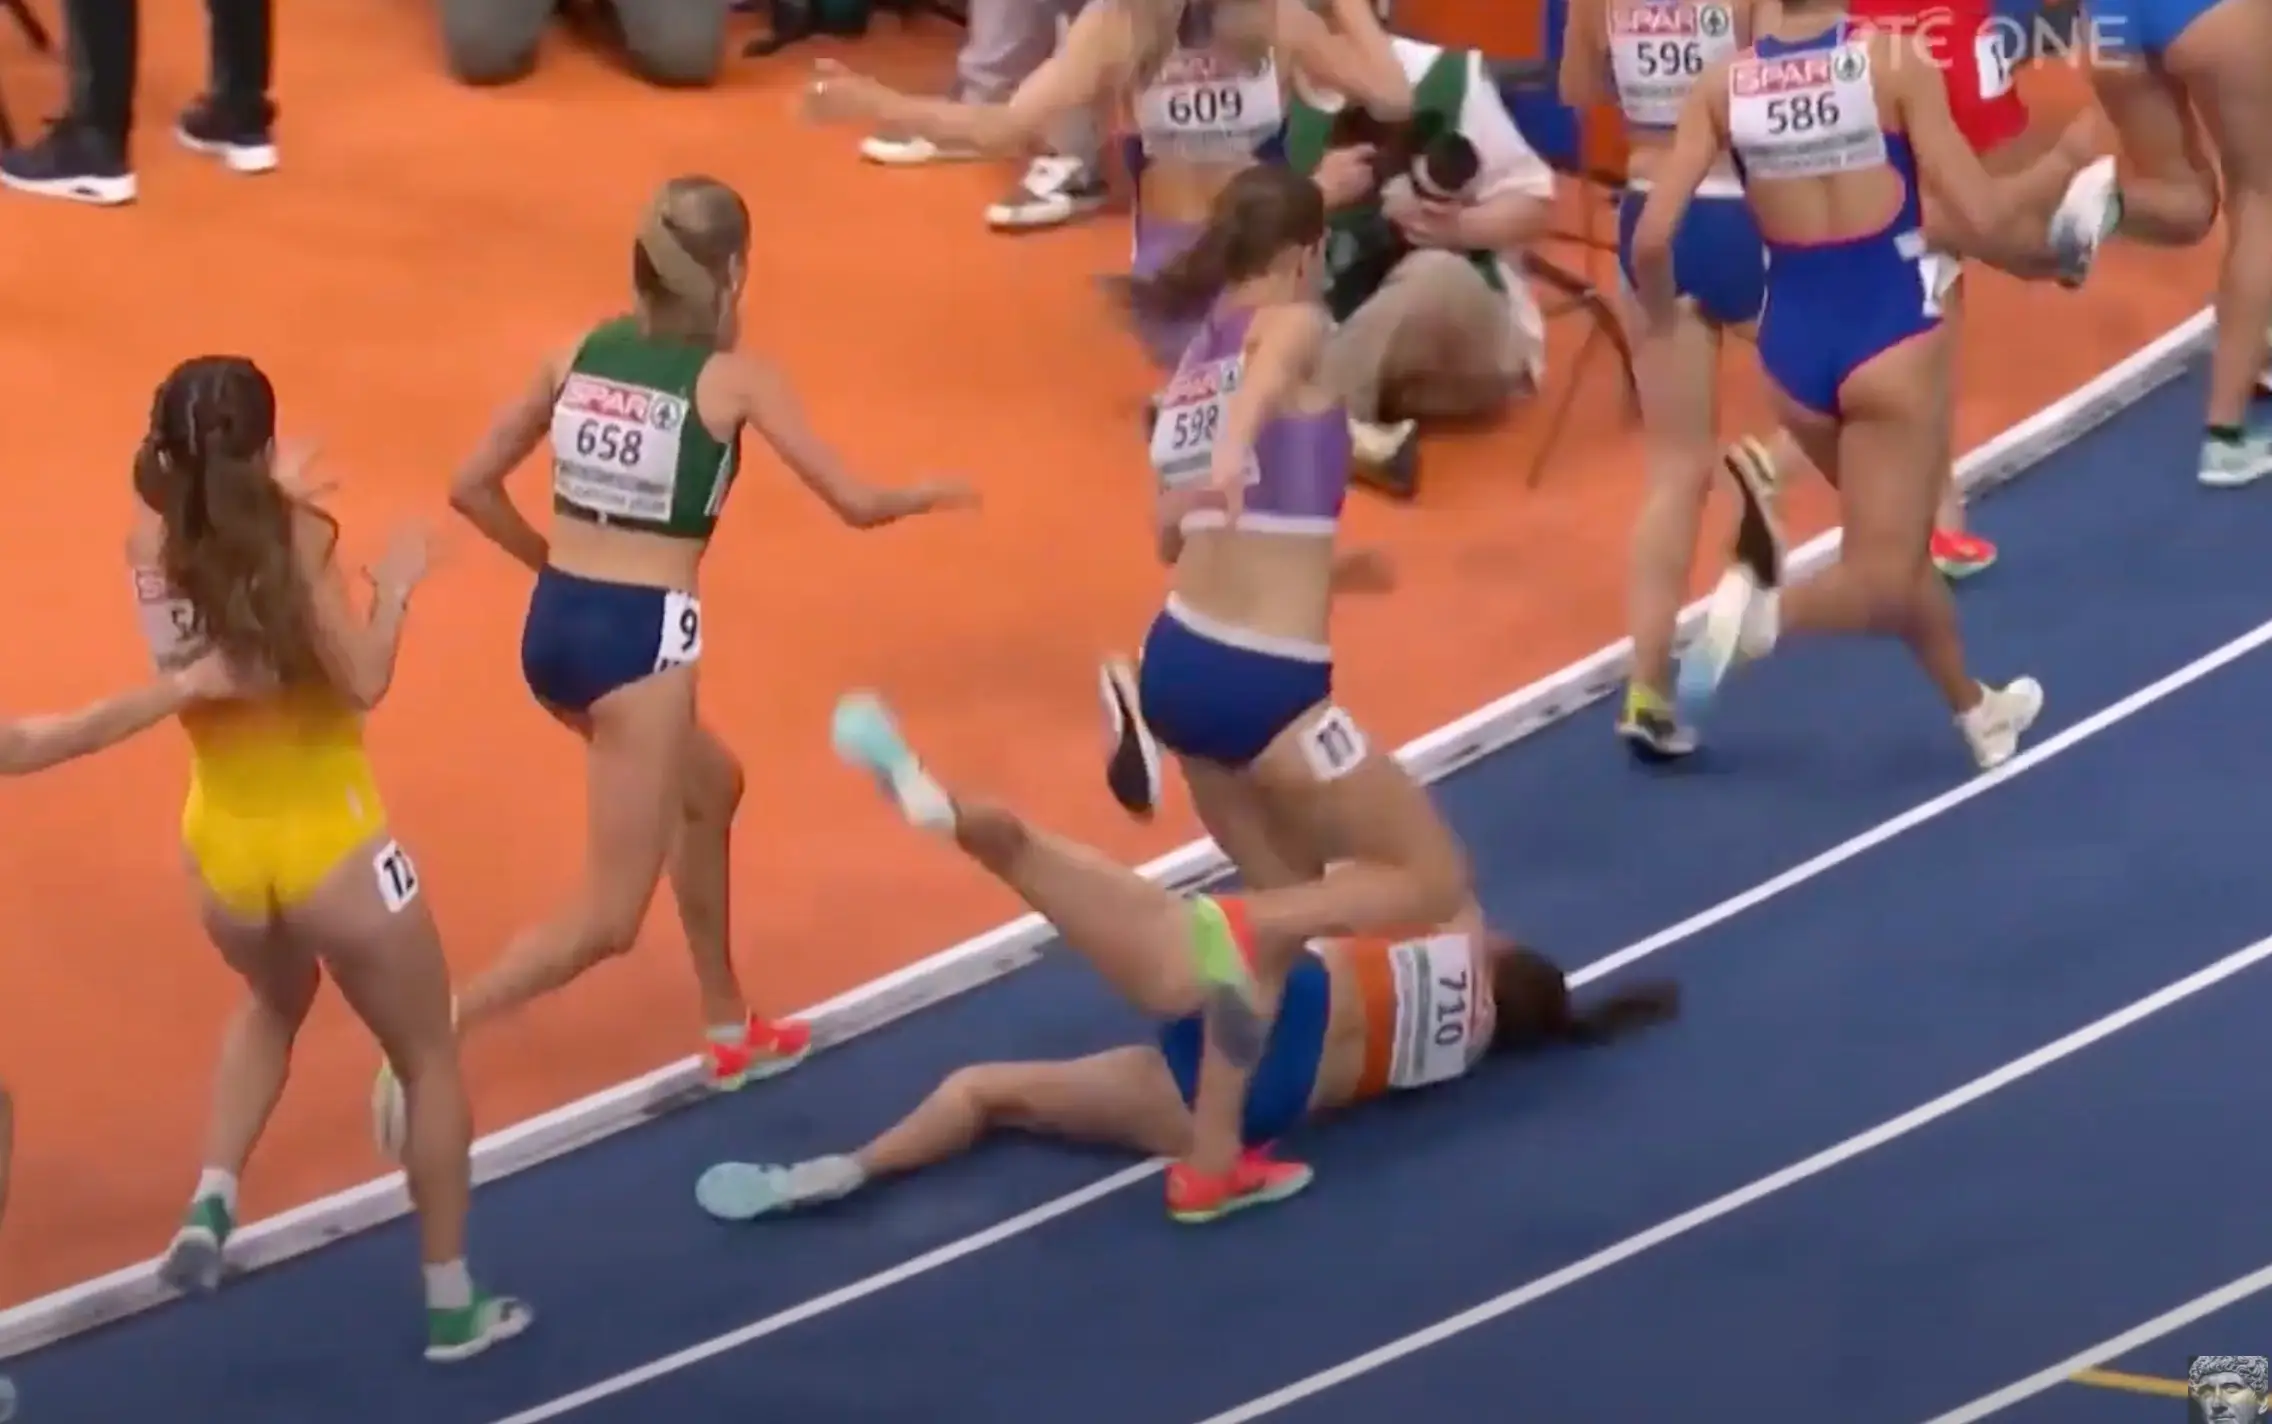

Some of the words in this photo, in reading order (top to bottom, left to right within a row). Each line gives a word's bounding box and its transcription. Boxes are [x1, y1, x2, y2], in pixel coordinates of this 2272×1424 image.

[1612, 5, 1697, 35] SPAR
[1638, 41, 1703, 77] 596
[1736, 57, 1830, 92] SPAR
[1169, 86, 1243, 126] 609
[1767, 92, 1841, 135] 586
[570, 382, 649, 423] SPAR
[576, 418, 643, 467] 658
[1172, 404, 1220, 450] 598
[680, 608, 697, 652] 9
[1435, 969, 1467, 1046] 710
